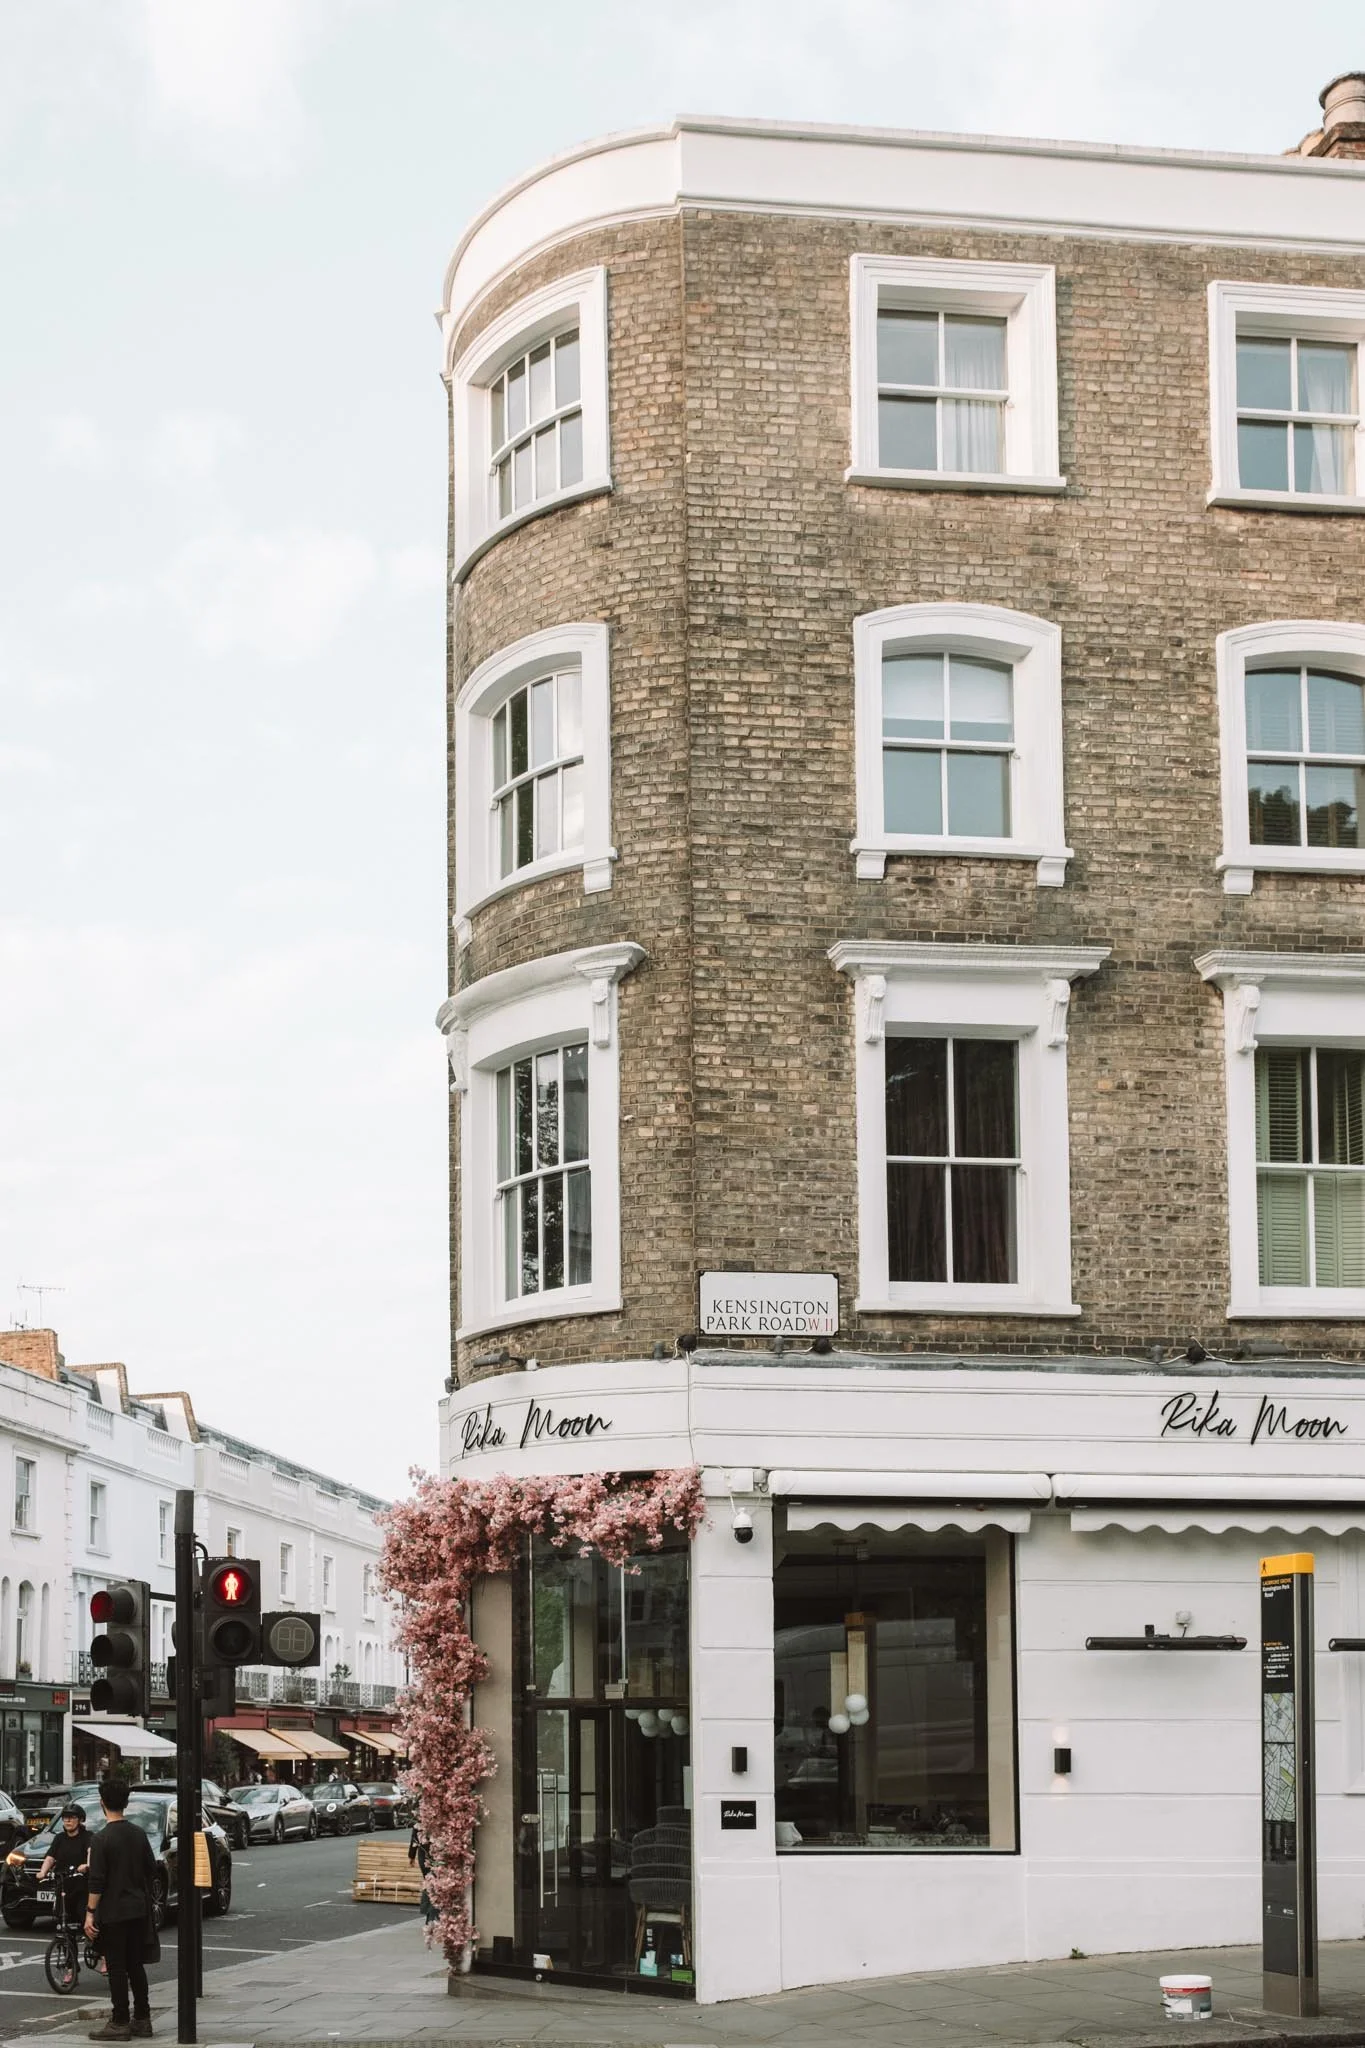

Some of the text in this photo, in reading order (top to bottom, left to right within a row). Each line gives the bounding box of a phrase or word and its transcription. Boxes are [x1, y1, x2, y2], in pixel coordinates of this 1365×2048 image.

[706, 1316, 752, 1331] PARK
[712, 1299, 829, 1315] KENSINGTON
[460, 1398, 613, 1460] Rika Moon
[1160, 1389, 1349, 1446] Rika Moon
